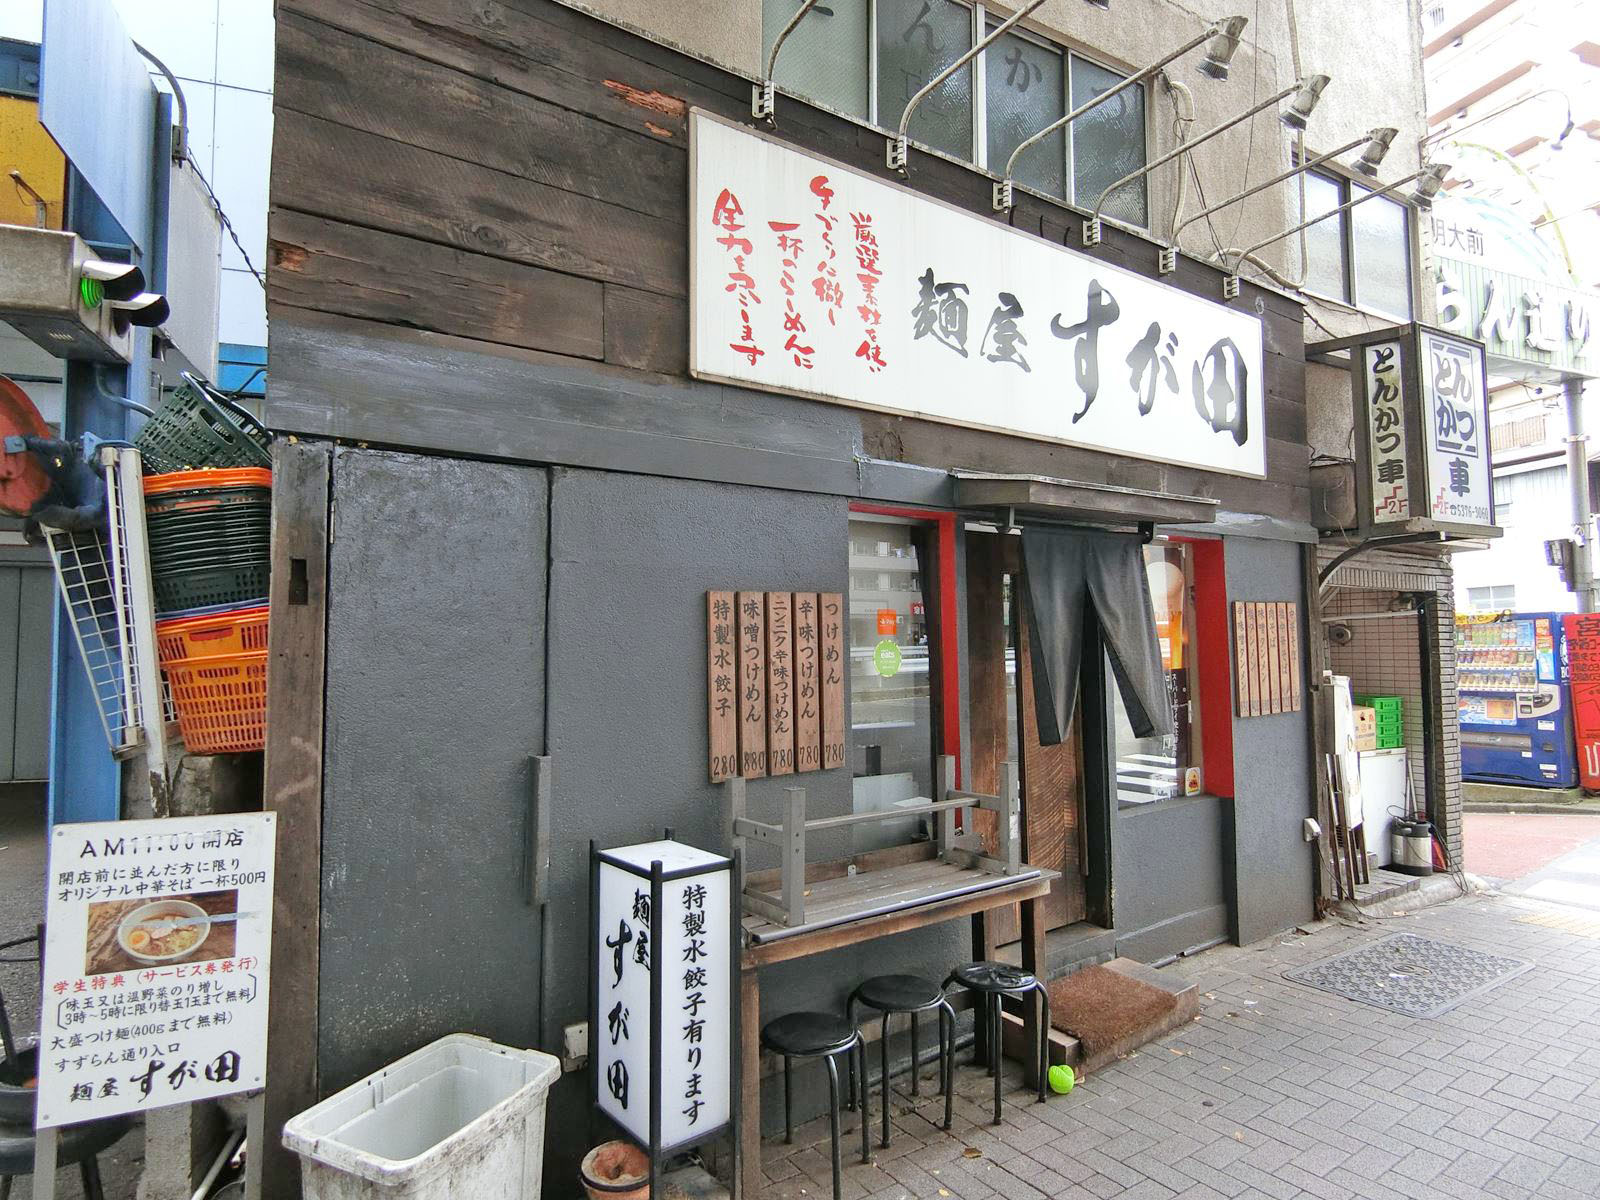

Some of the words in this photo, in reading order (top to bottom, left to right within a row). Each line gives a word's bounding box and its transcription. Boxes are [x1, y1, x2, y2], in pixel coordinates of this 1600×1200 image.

[1449, 457, 1471, 498] 車
[1388, 499, 1408, 514] 2F
[713, 599, 732, 718] 特製水餃子
[825, 602, 840, 685] つけめん
[743, 599, 761, 722] 味噌つけめん
[772, 601, 790, 733] ニンニク辛味つけめん
[798, 600, 816, 719] 辛味つけめん
[713, 755, 736, 776] 280
[744, 751, 765, 771] 880
[773, 749, 793, 769] 780
[799, 745, 819, 765] 780
[825, 743, 844, 762] 780
[58, 858, 240, 886] 開店前に並んだ方に限り
[58, 876, 196, 901] オリジナル中華そば
[200, 871, 267, 888] 一杯500円
[53, 974, 126, 995] 学生特典
[606, 918, 633, 1110] すが田
[682, 883, 709, 1127] 特製水餃子有ります
[54, 1042, 181, 1073] すずらん通り入口
[129, 1050, 241, 1104] すが田
